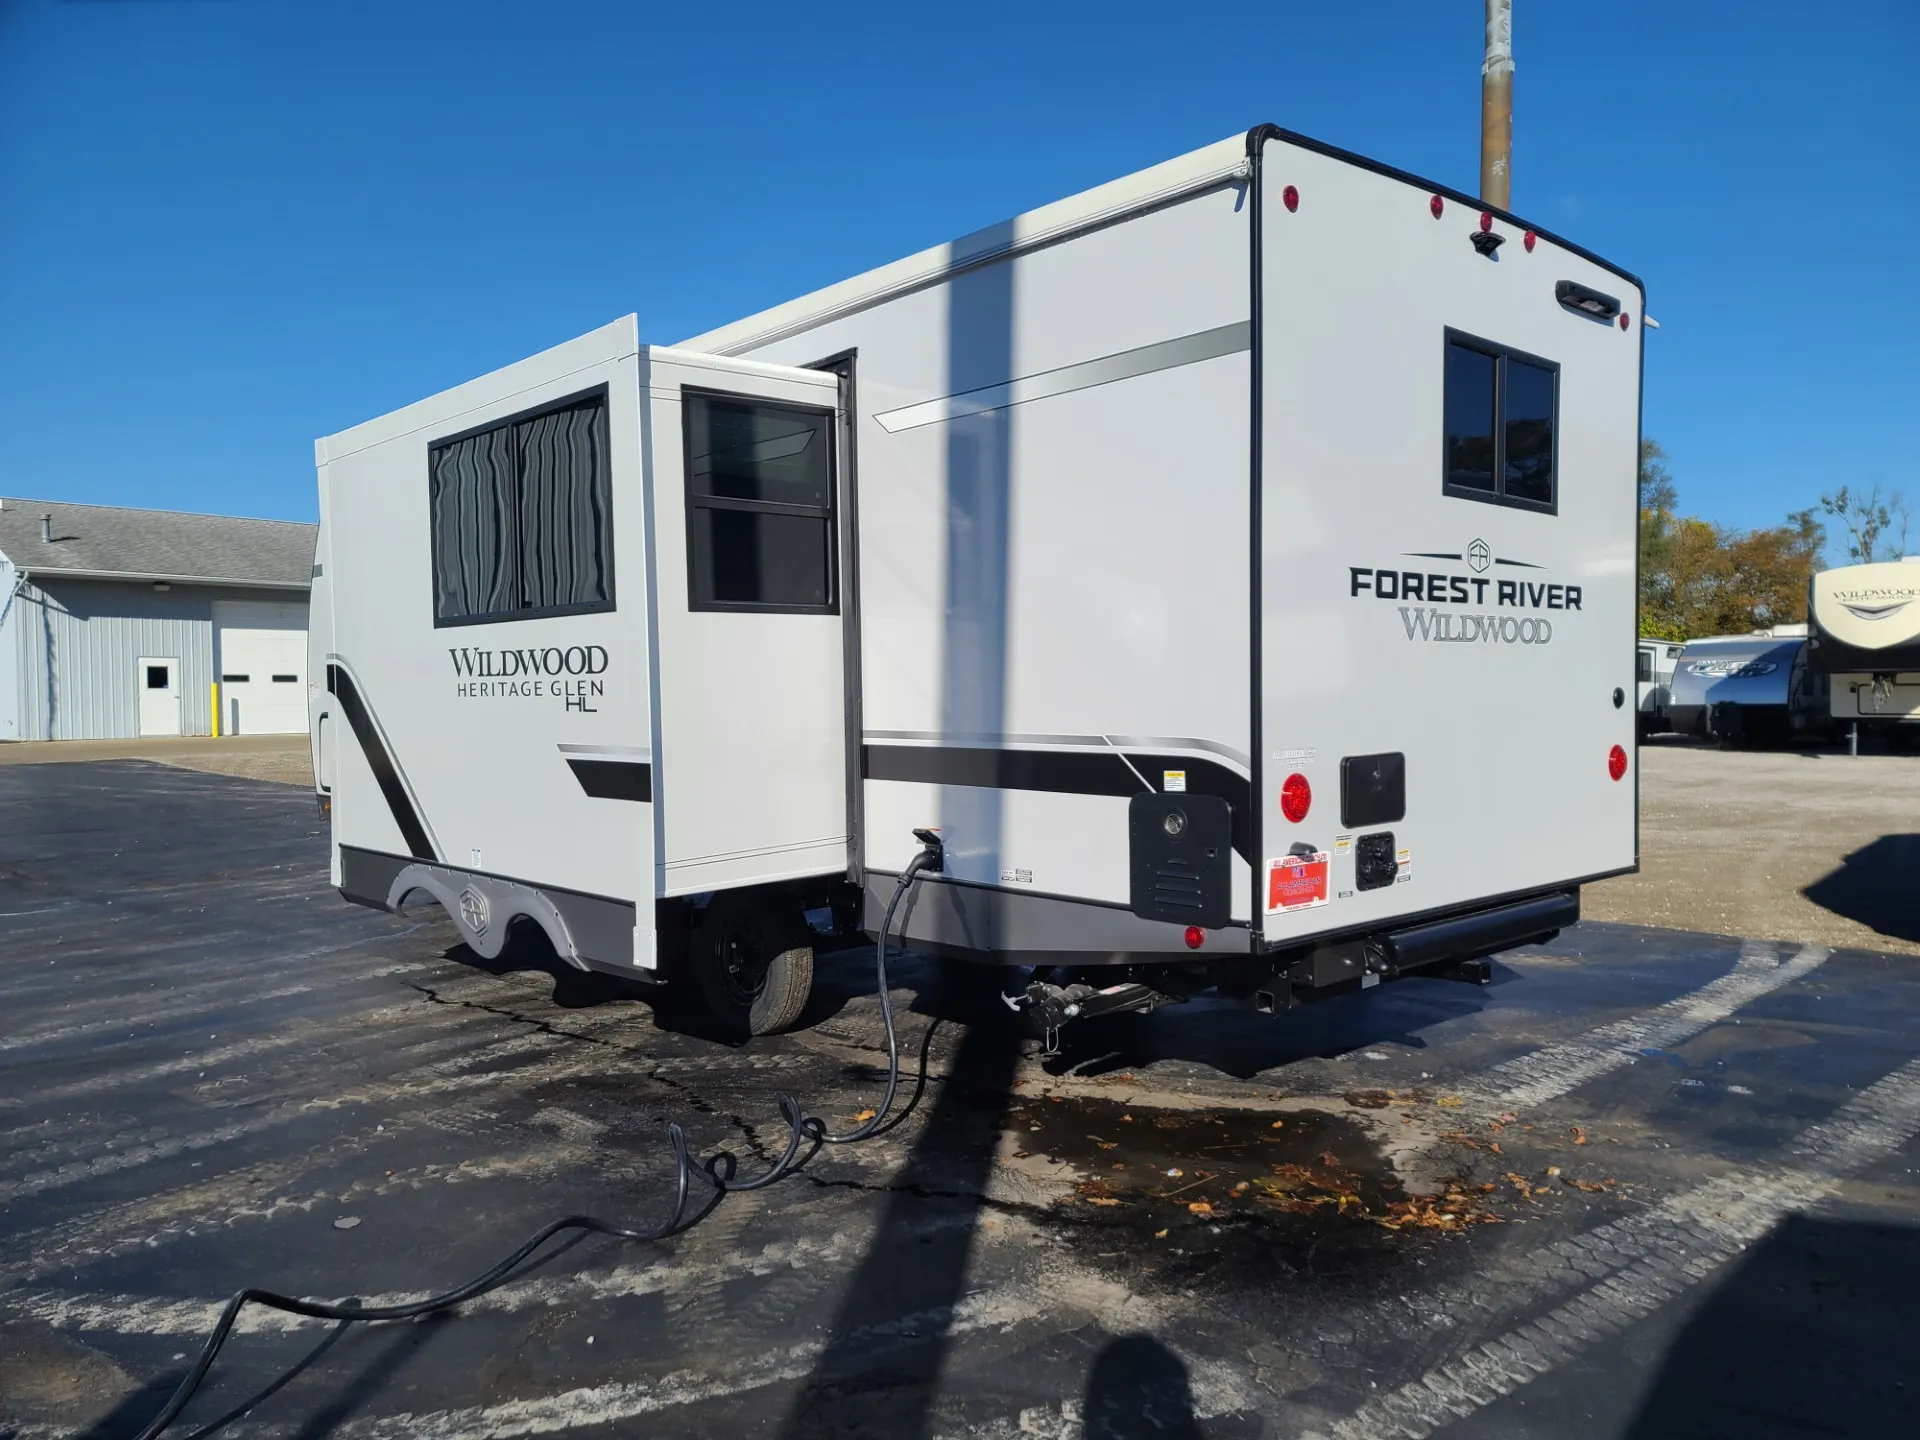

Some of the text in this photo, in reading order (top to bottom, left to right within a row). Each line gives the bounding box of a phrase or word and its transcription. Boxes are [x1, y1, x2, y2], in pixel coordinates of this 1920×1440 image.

[1349, 567, 1582, 610] FOREST RIVER
[449, 645, 609, 677] WILDWOOD
[457, 680, 604, 697] HERITAGE GLEN
[566, 697, 597, 712] HL
